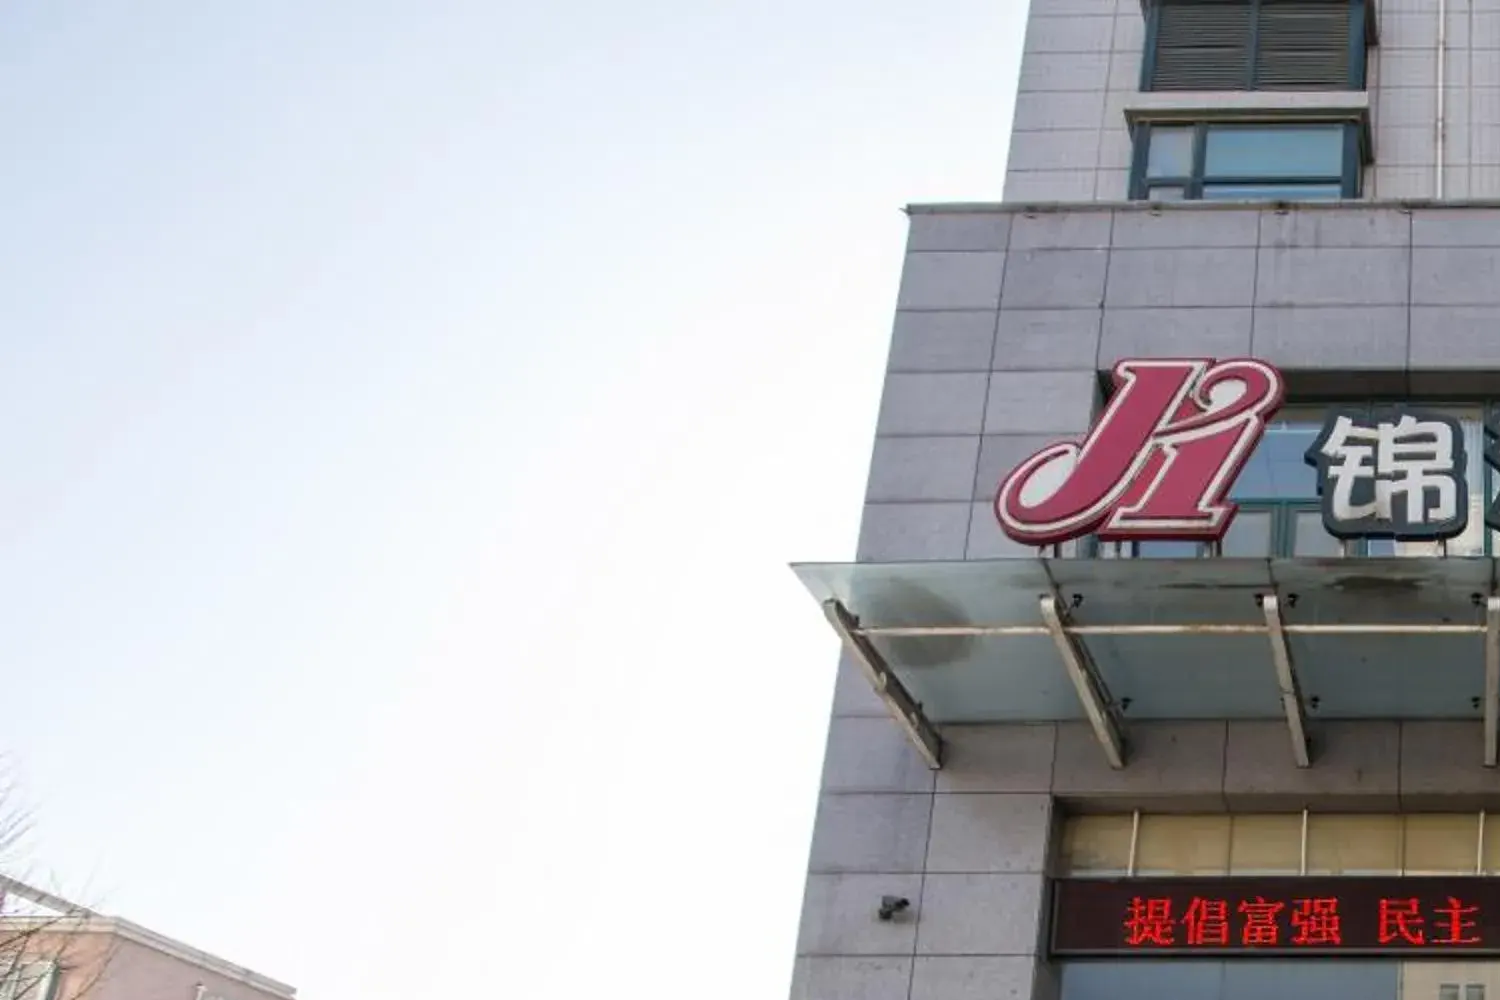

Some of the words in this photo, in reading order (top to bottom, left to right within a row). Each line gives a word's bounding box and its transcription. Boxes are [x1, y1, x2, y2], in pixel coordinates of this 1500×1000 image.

[1122, 896, 1342, 946] 提倡富强
[1377, 896, 1480, 945] 民主
